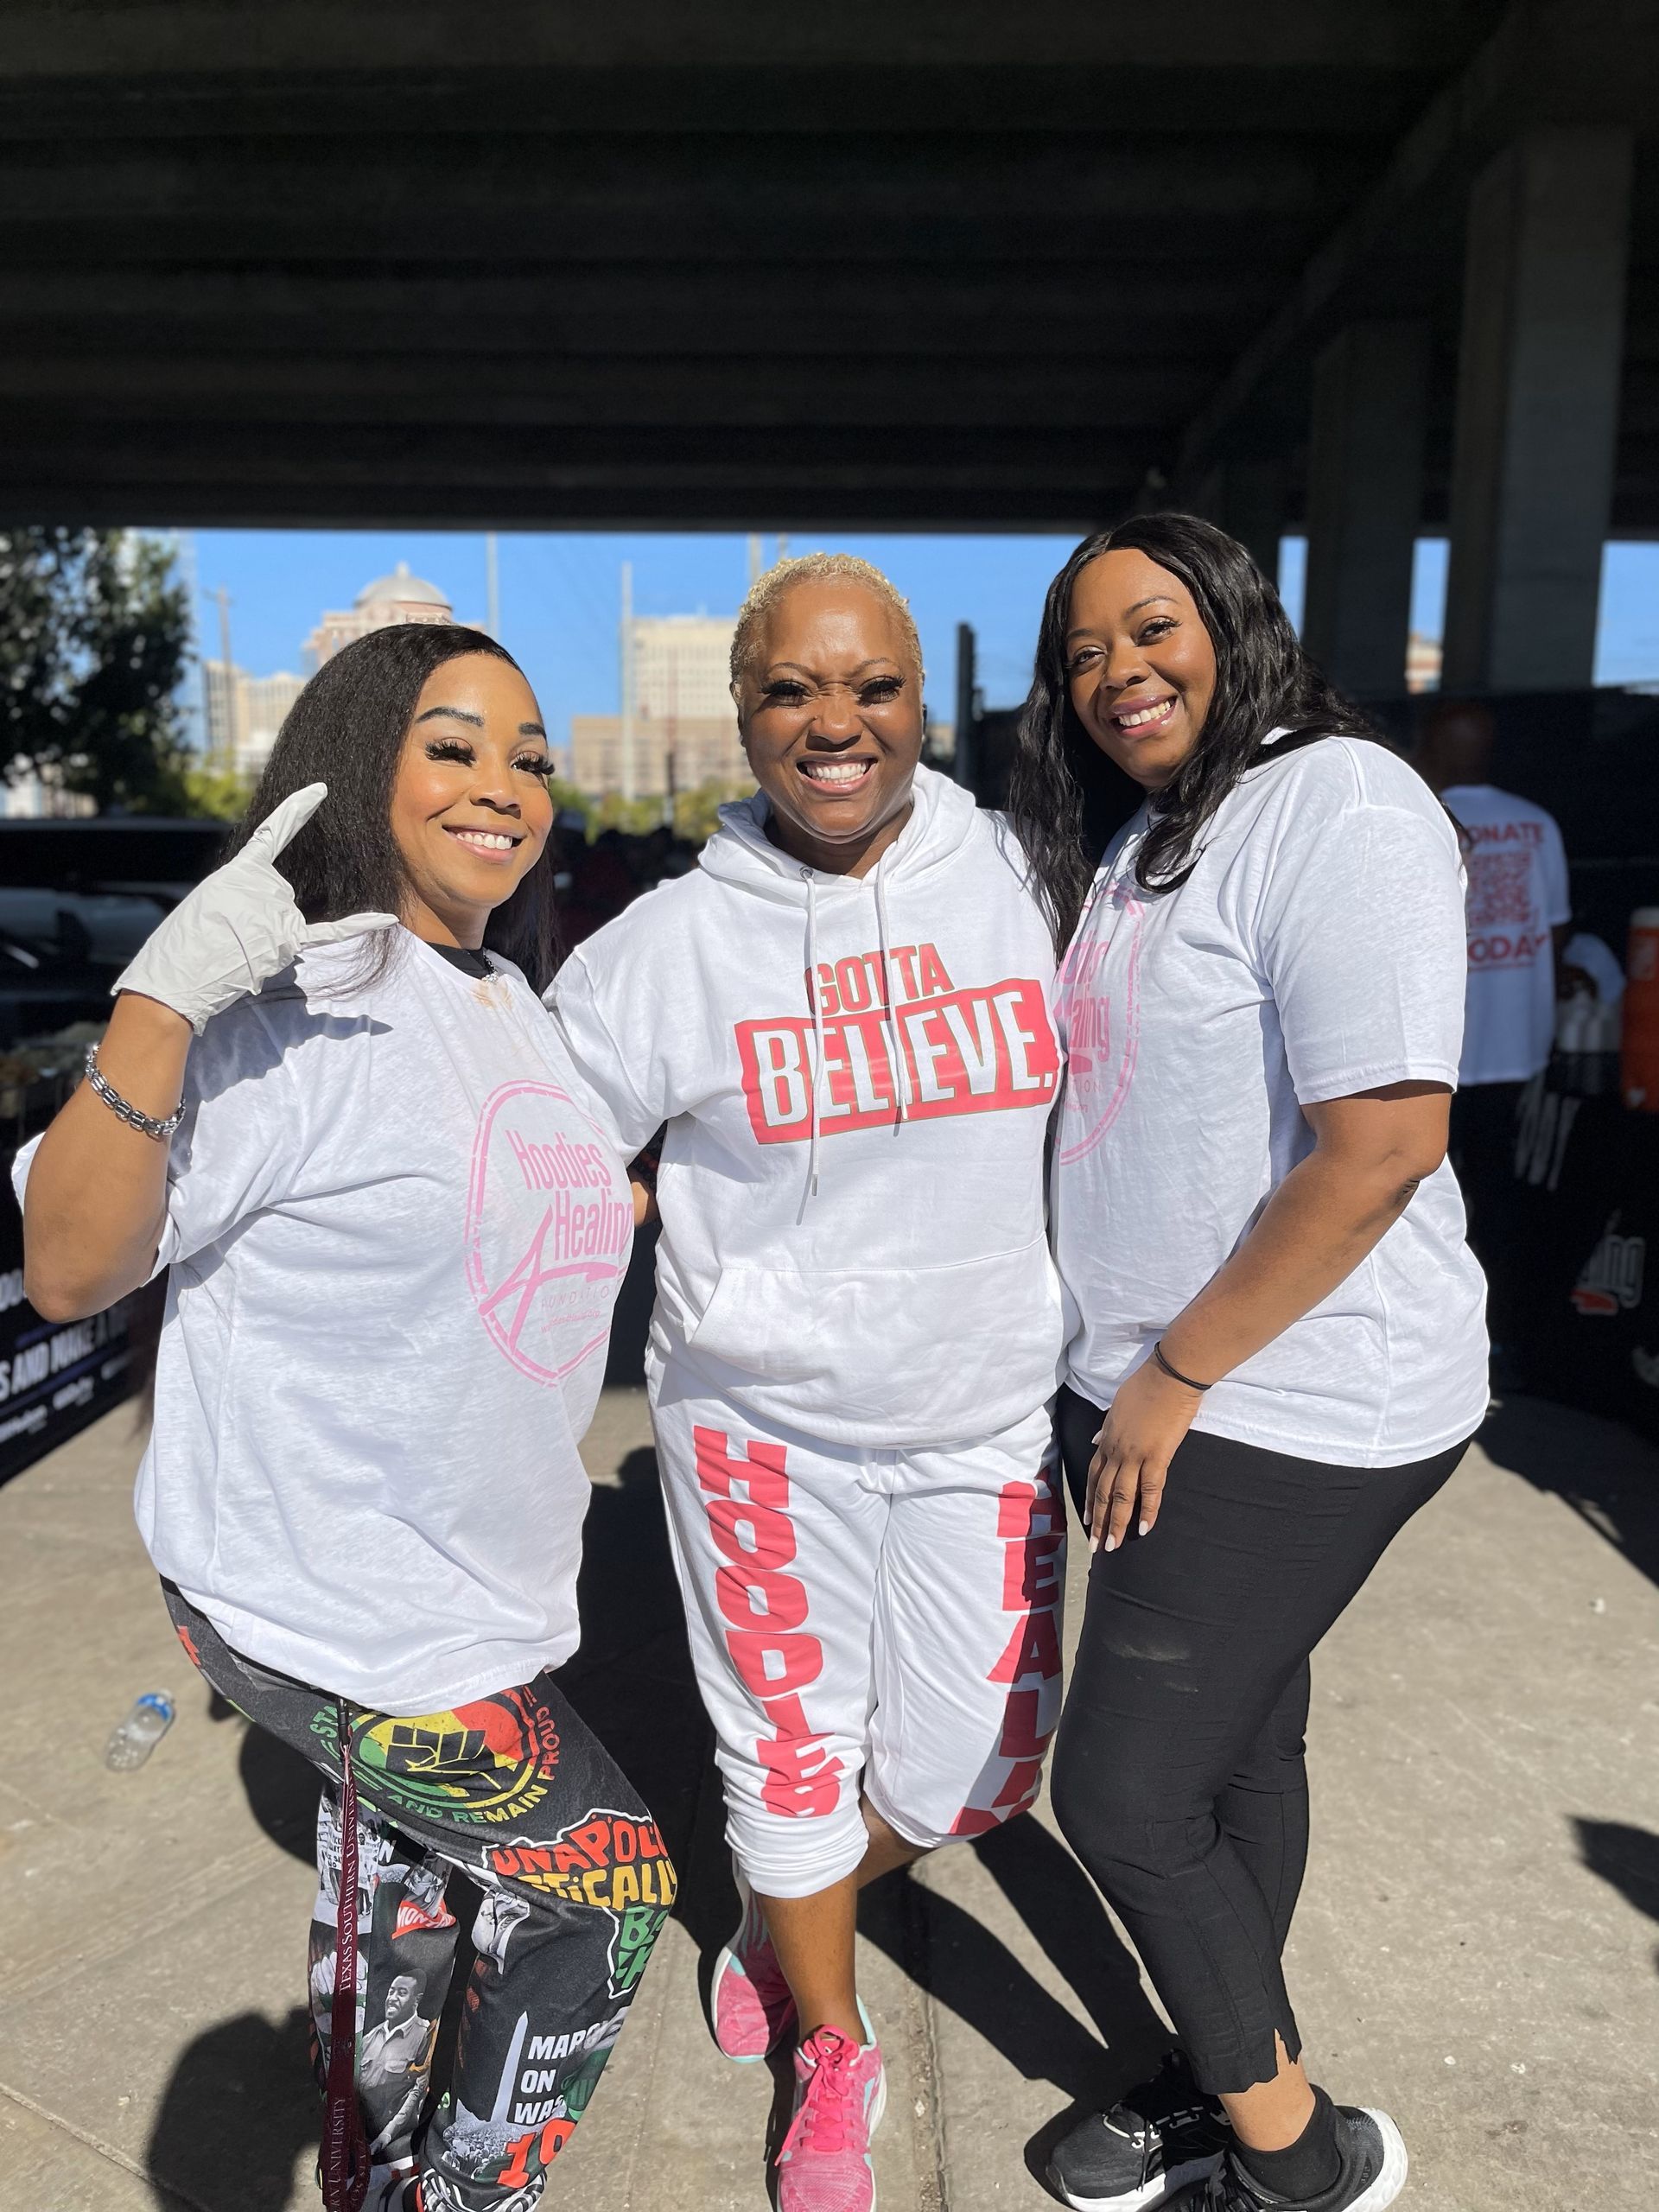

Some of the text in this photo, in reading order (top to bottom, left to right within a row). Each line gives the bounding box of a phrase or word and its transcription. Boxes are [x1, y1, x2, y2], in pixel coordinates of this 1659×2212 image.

[804, 943, 955, 1016] GOTTA
[752, 991, 1053, 1126] BELIEVE.
[505, 1130, 613, 1191] Hoodies
[694, 1425, 845, 1817] HOODIES
[388, 1706, 560, 1823] AND REMAIN PROUD
[340, 1859, 356, 1944] SOUTHERN
[339, 1951, 353, 1996] TEXAS
[521, 2069, 556, 2094] ON
